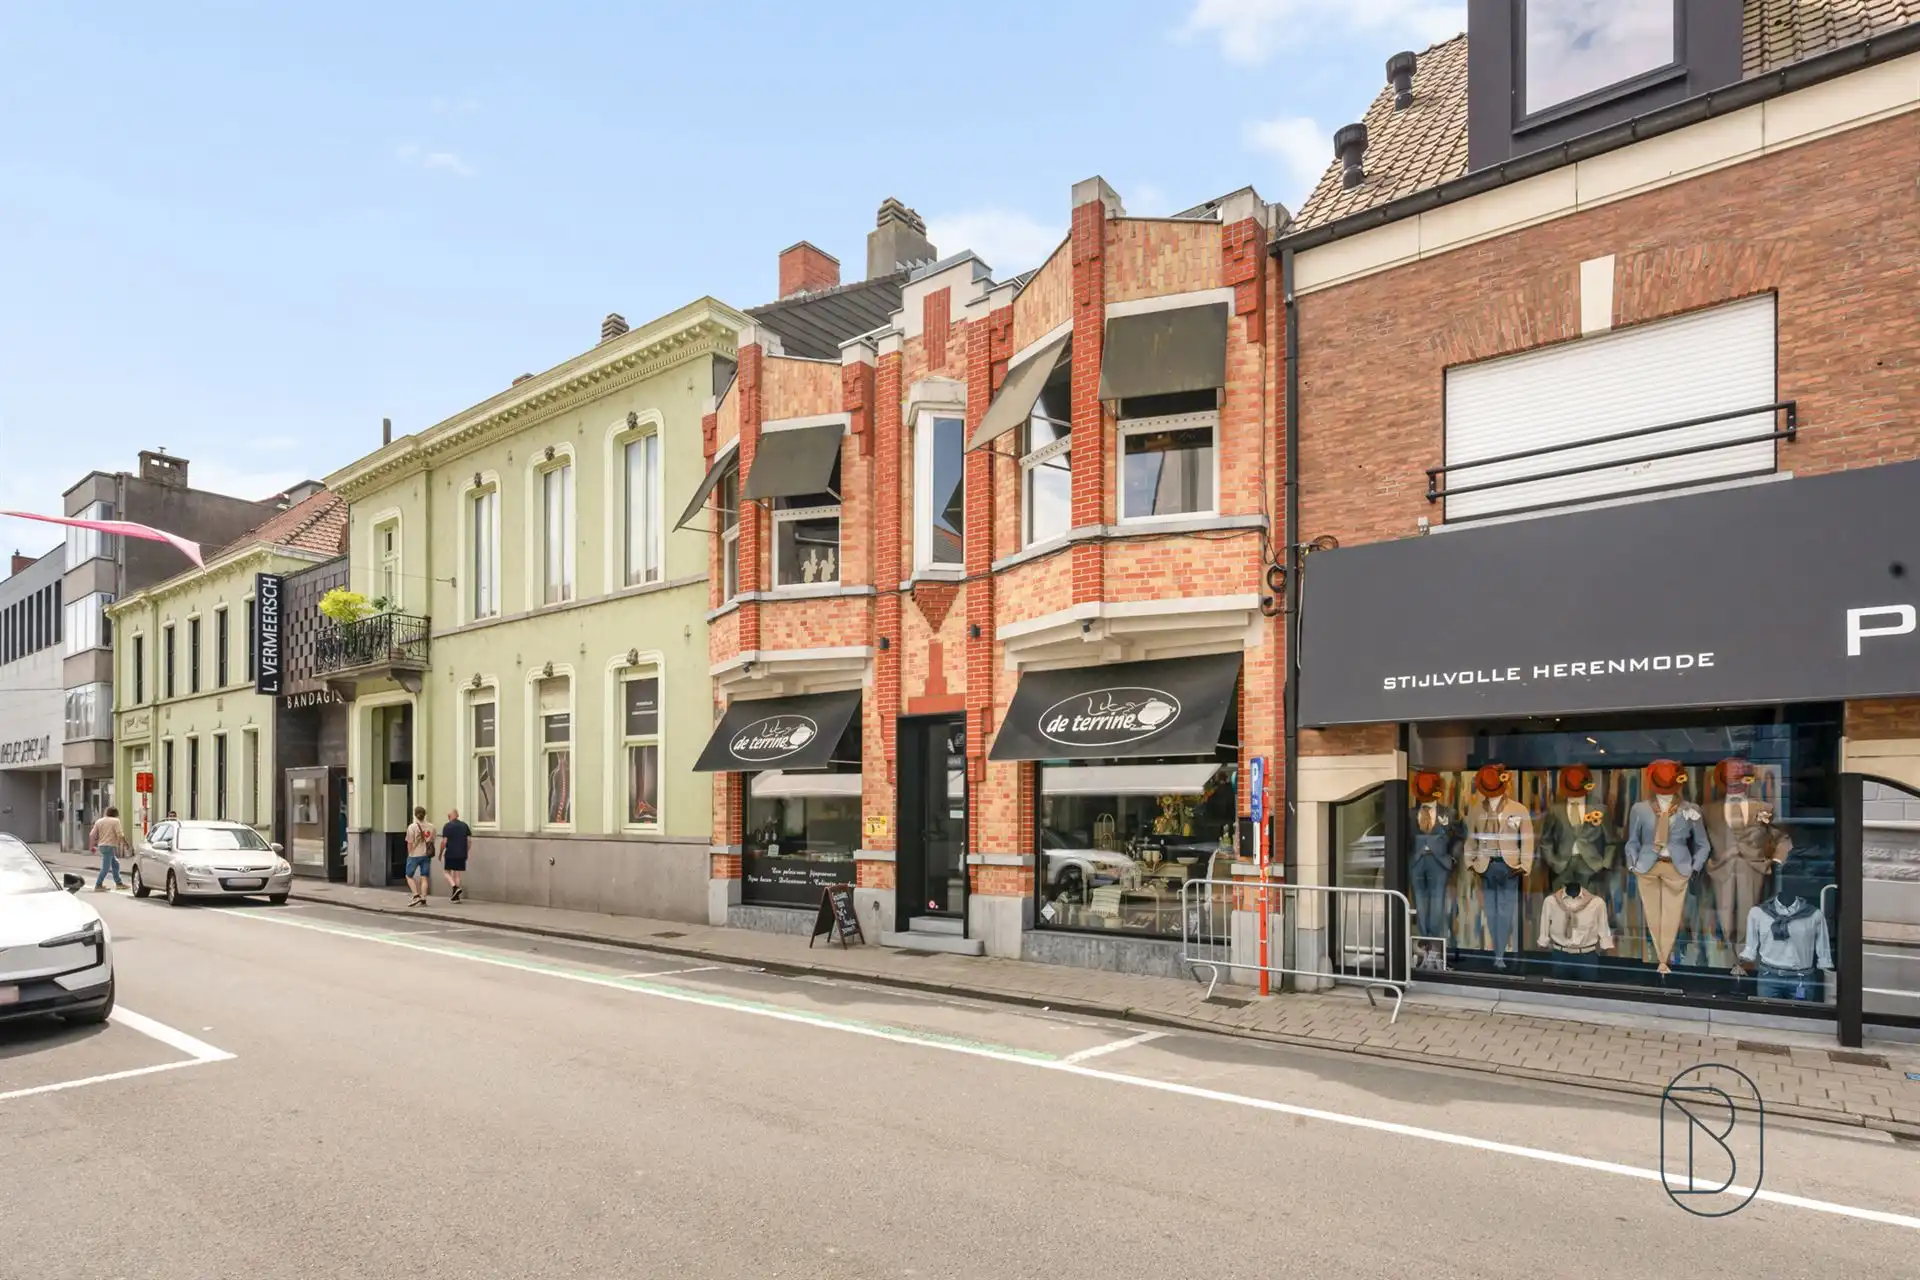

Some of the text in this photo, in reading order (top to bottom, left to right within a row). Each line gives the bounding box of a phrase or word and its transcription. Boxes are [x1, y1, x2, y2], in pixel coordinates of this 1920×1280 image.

[263, 577, 278, 692] L. VERMEERSCH
[1383, 652, 1715, 690] STIJLVOLLE HERENMODE
[287, 690, 343, 709] BANDAGI
[1046, 711, 1137, 732] de terrine
[733, 734, 790, 750] de terrine
